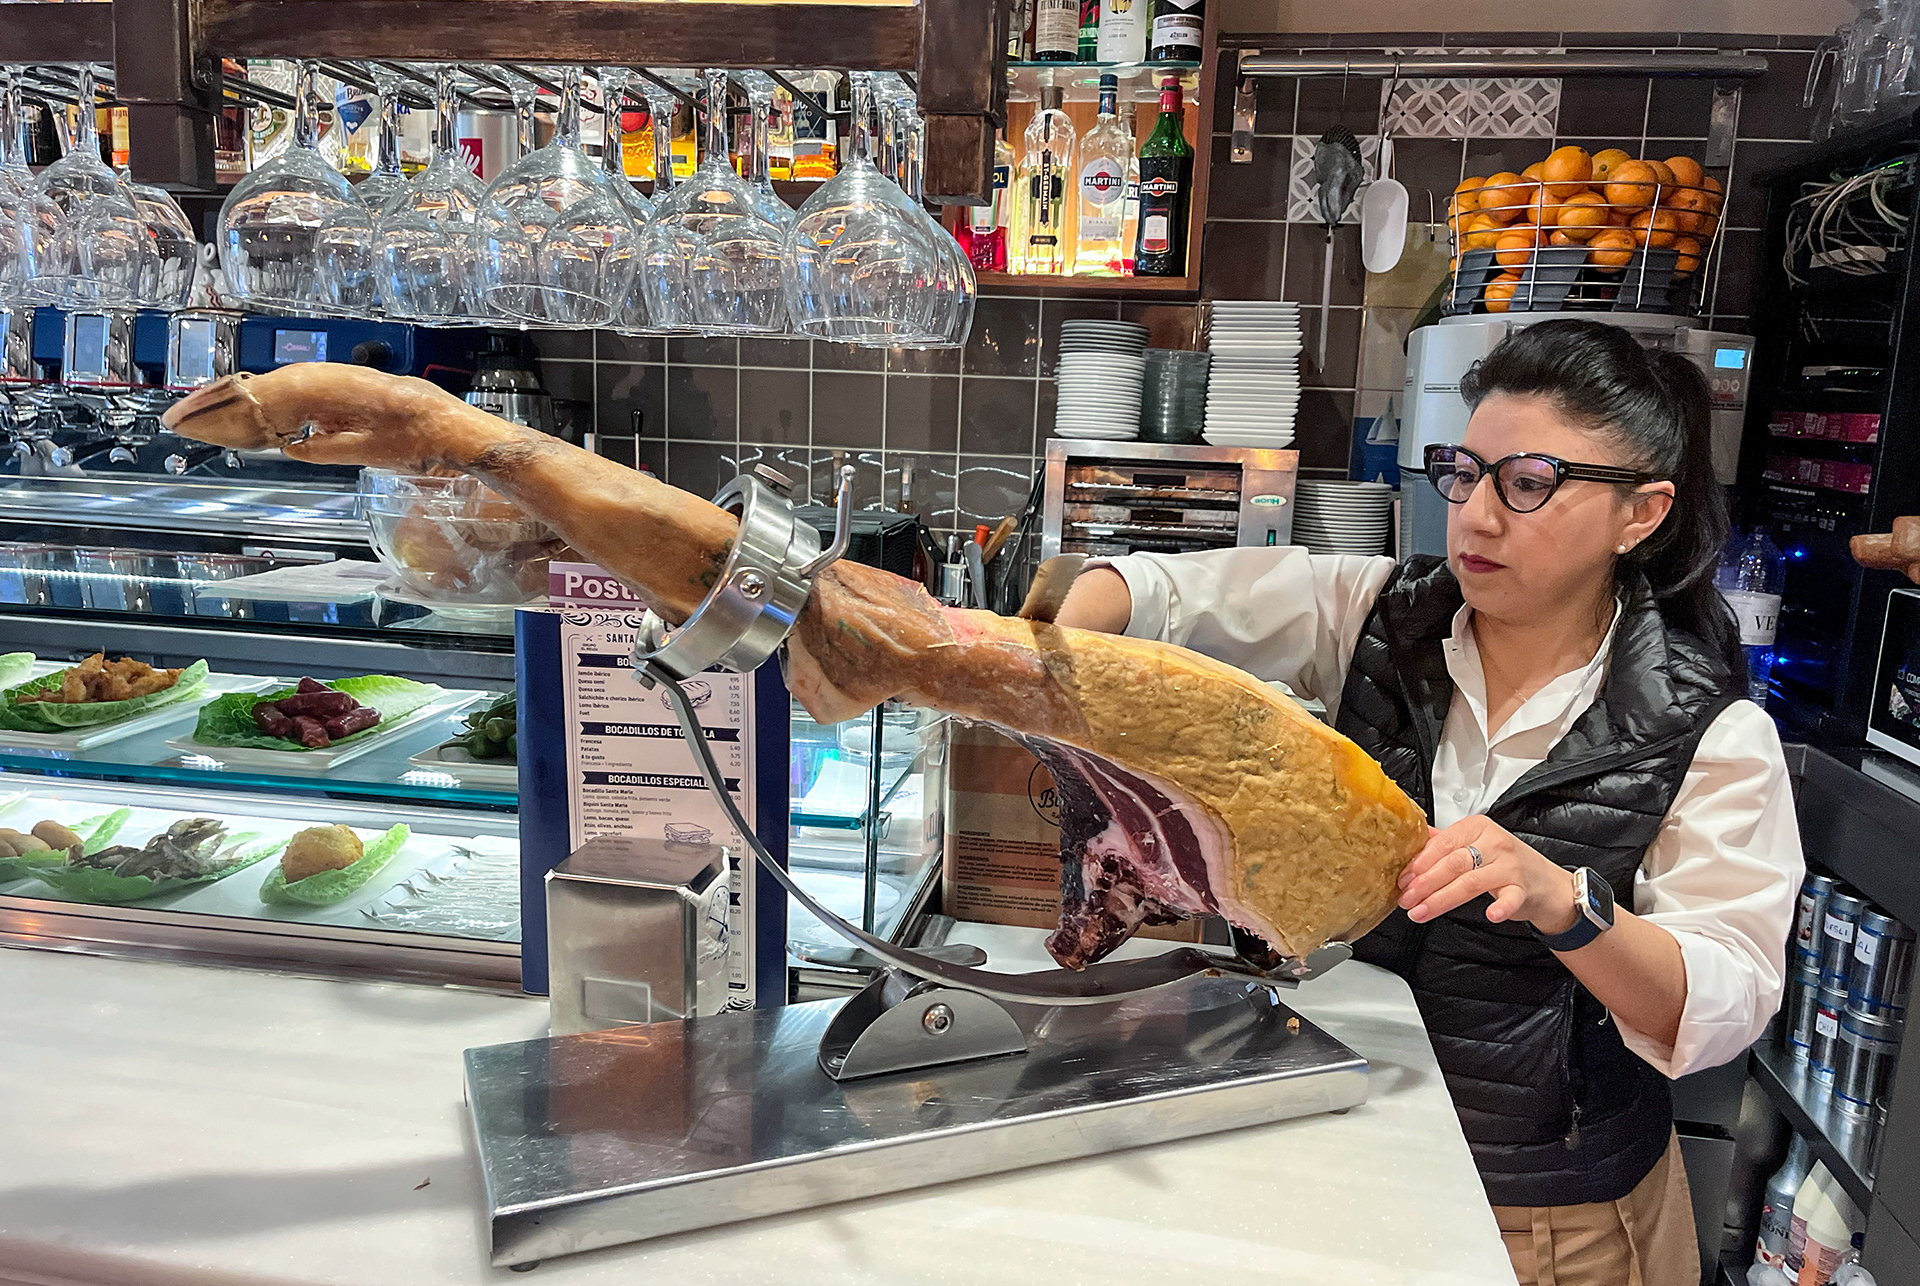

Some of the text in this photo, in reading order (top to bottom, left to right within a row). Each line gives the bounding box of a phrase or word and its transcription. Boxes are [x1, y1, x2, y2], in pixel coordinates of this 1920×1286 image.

[1084, 178, 1121, 186] MARTINI
[1142, 183, 1175, 191] MARTINI
[606, 633, 635, 643] SANTA
[605, 725, 715, 739] BOCADILLOS DE TOLA
[608, 774, 709, 788] BOCADILLOS ESPECIALE
